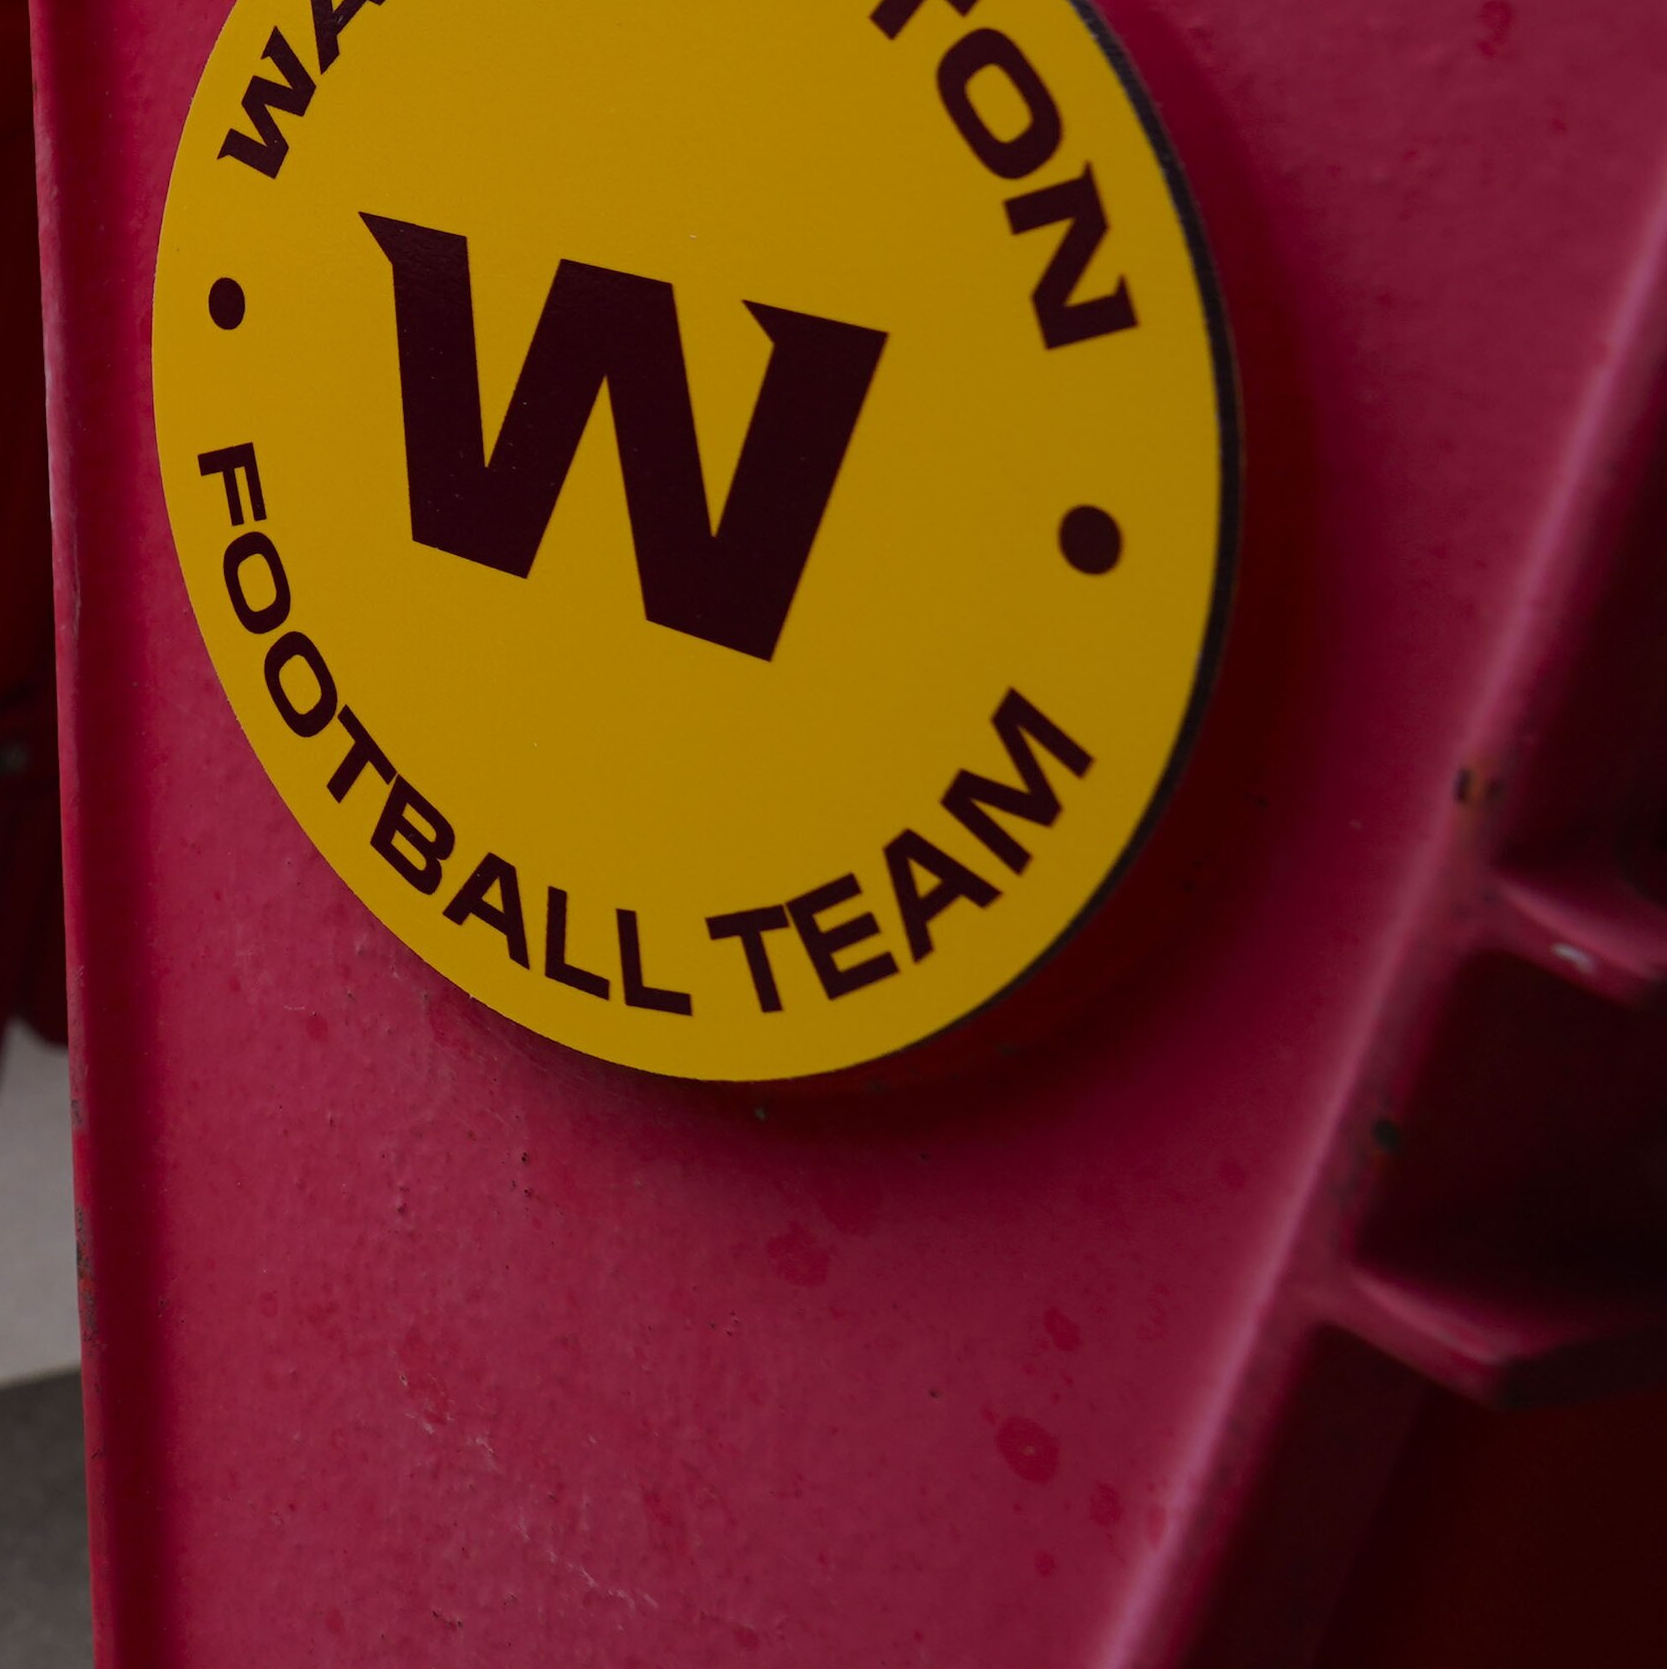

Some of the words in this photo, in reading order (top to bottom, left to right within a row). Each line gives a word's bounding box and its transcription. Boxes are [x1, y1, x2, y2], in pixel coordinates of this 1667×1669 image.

[358, 211, 889, 662] W
[197, 442, 693, 1017] FOOTBALL
[704, 687, 1094, 1014] TEAM
